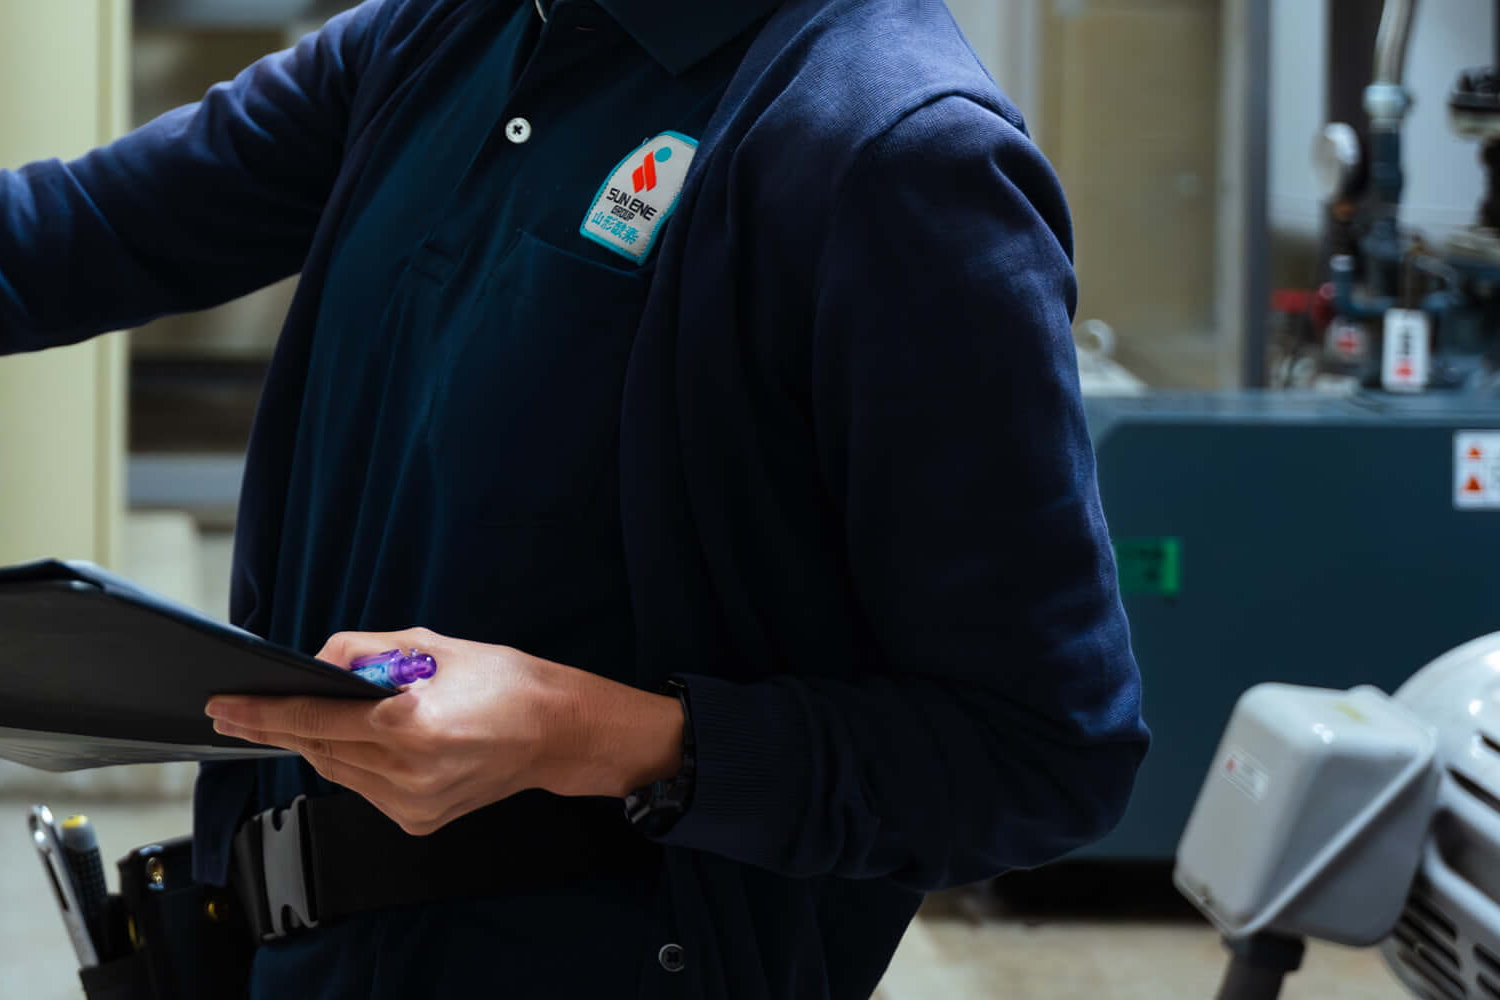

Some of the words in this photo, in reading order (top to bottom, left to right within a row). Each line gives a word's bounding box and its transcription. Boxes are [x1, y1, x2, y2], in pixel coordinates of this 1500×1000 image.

[606, 188, 632, 207] SUN
[629, 197, 658, 221] ENE
[611, 205, 636, 221] GROUP
[591, 211, 639, 245] 山形酸素
